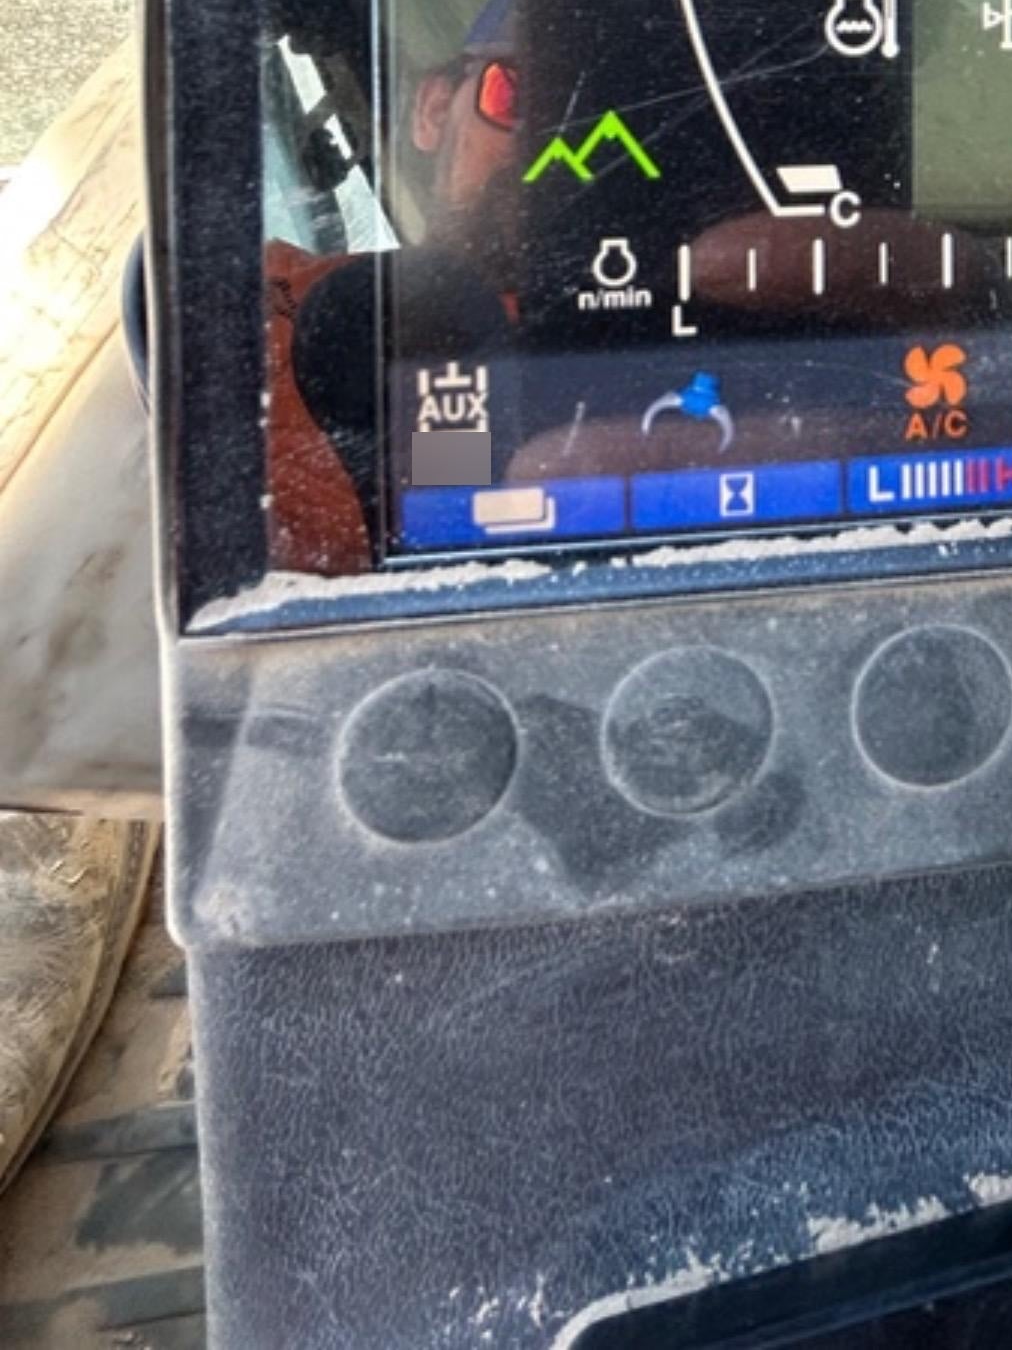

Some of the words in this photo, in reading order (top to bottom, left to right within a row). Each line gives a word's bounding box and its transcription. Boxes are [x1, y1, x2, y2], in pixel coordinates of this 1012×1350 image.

[829, 191, 861, 227] C
[577, 287, 652, 310] n/min
[671, 305, 697, 336] L
[418, 394, 487, 423] AUX
[905, 410, 969, 439] A/C
[869, 465, 895, 501] L
